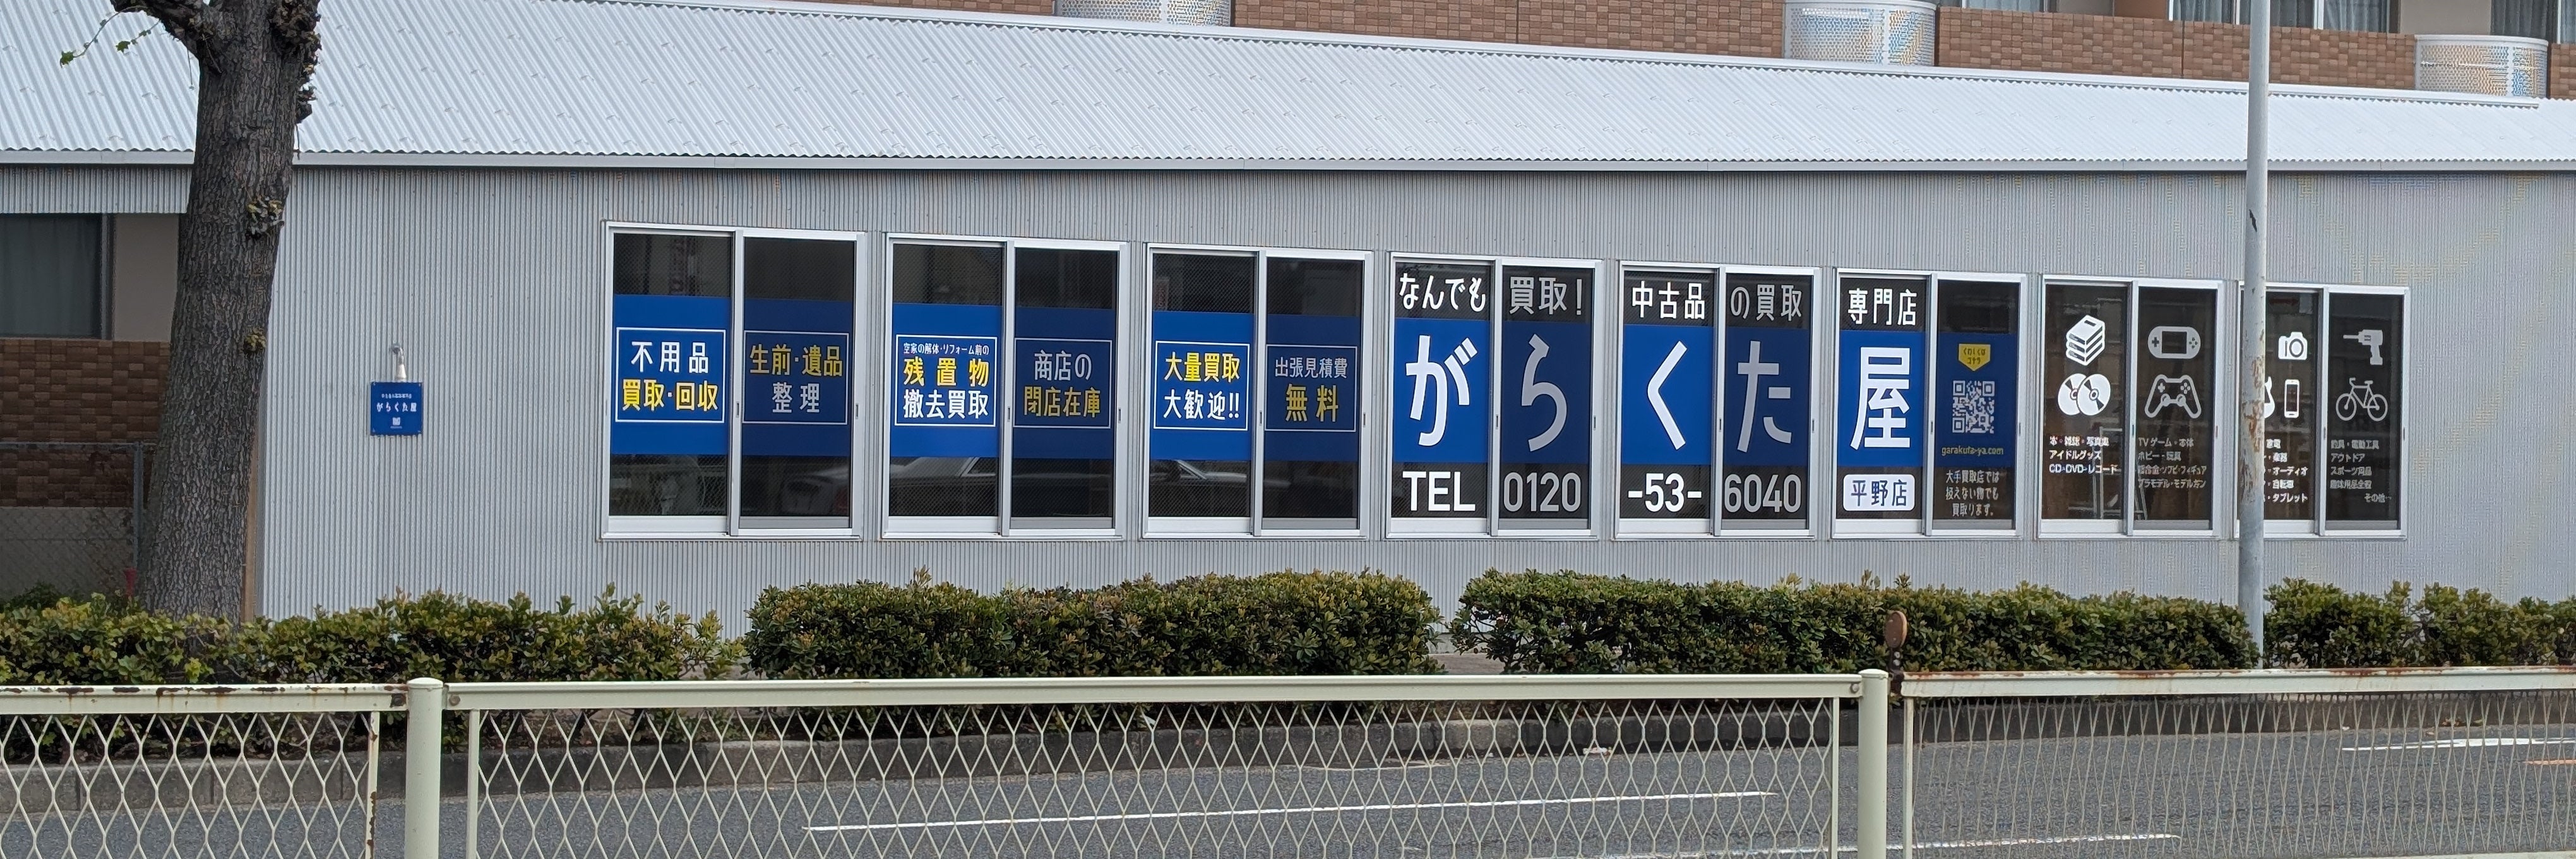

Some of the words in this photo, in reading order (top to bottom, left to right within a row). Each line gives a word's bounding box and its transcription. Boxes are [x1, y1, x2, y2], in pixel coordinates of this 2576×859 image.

[1399, 273, 1486, 312] なんでも
[1632, 280, 1705, 320] 中古品
[1731, 284, 1802, 321] の買取
[1847, 288, 1917, 326] 専門店
[631, 341, 709, 373] 不用品
[749, 344, 843, 376] 生前・遺品
[903, 356, 989, 387] 残置物
[1034, 350, 1092, 381] 商店の
[1164, 352, 1241, 383] 大量買取
[1274, 356, 1349, 379] 出張見積費
[622, 379, 719, 411] 買取・回収
[772, 381, 820, 413] 整理
[903, 389, 988, 419] 撤去買取
[1023, 386, 1101, 417] 閉店在庫
[1285, 383, 1339, 422] 無料
[1941, 445, 2004, 457] garakuta-ya.com
[2049, 449, 2102, 460] アイドルグッズ
[2330, 453, 2365, 462] アウトドア
[1402, 471, 1476, 511] TEL
[1503, 472, 1581, 512] 0120
[1724, 474, 1801, 513] 6040
[1945, 470, 2000, 484] 大手買取店では
[1851, 479, 1907, 507] 平野店
[1945, 486, 1999, 500] 扱えない物でも
[1952, 503, 1994, 517] 買取ります。
